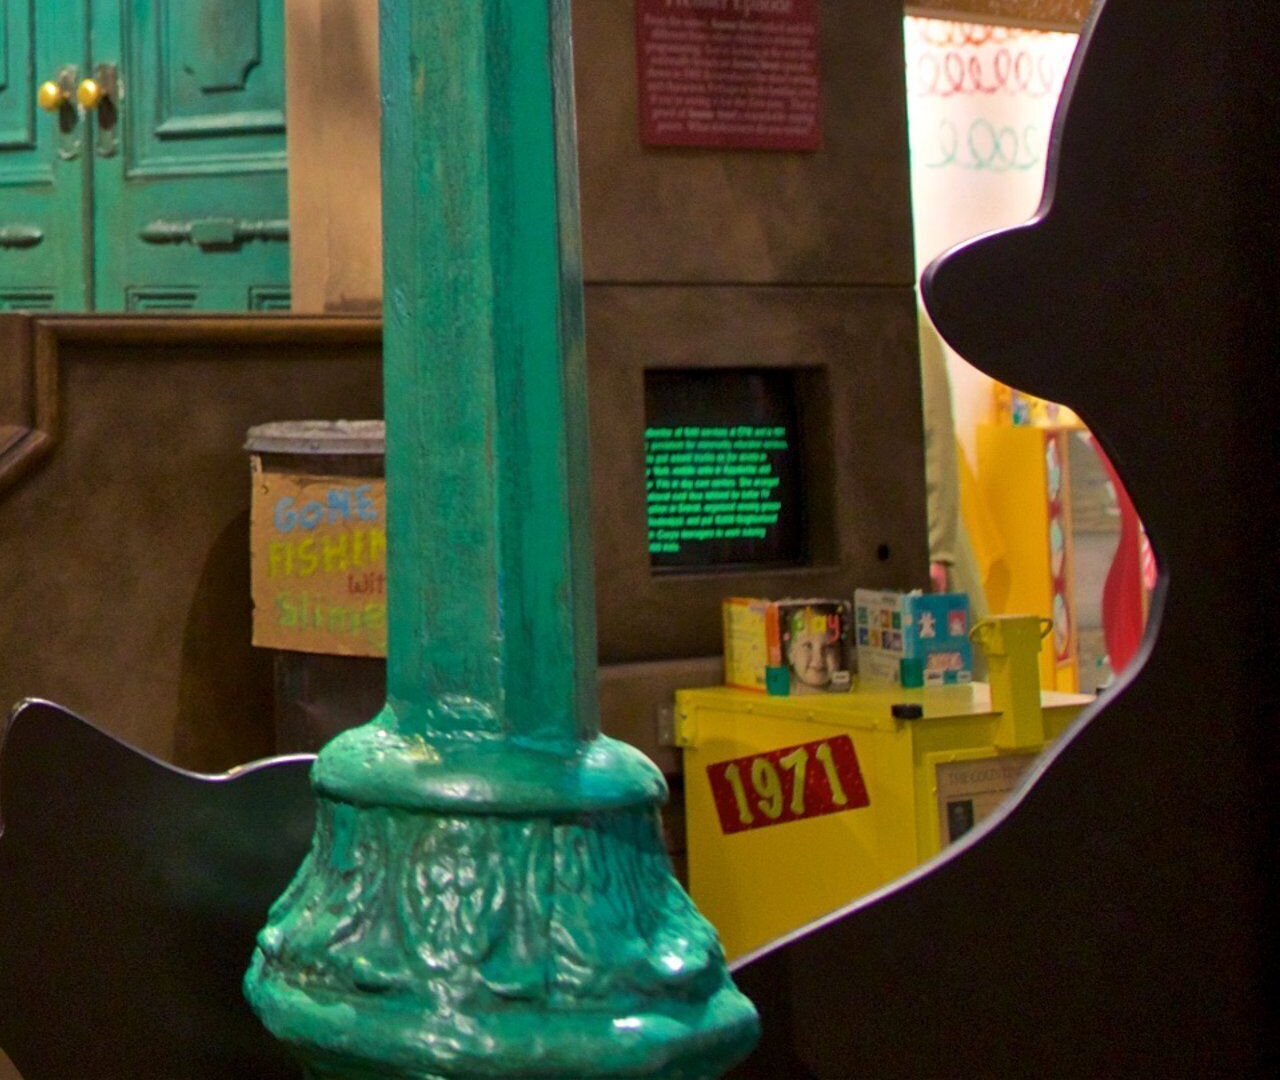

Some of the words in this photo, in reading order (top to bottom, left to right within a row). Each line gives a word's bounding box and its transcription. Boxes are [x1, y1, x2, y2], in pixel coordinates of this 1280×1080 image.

[274, 483, 379, 533] GONE
[267, 527, 386, 581] FISHIN
[275, 590, 386, 637] Slime
[723, 741, 848, 825] 1971
